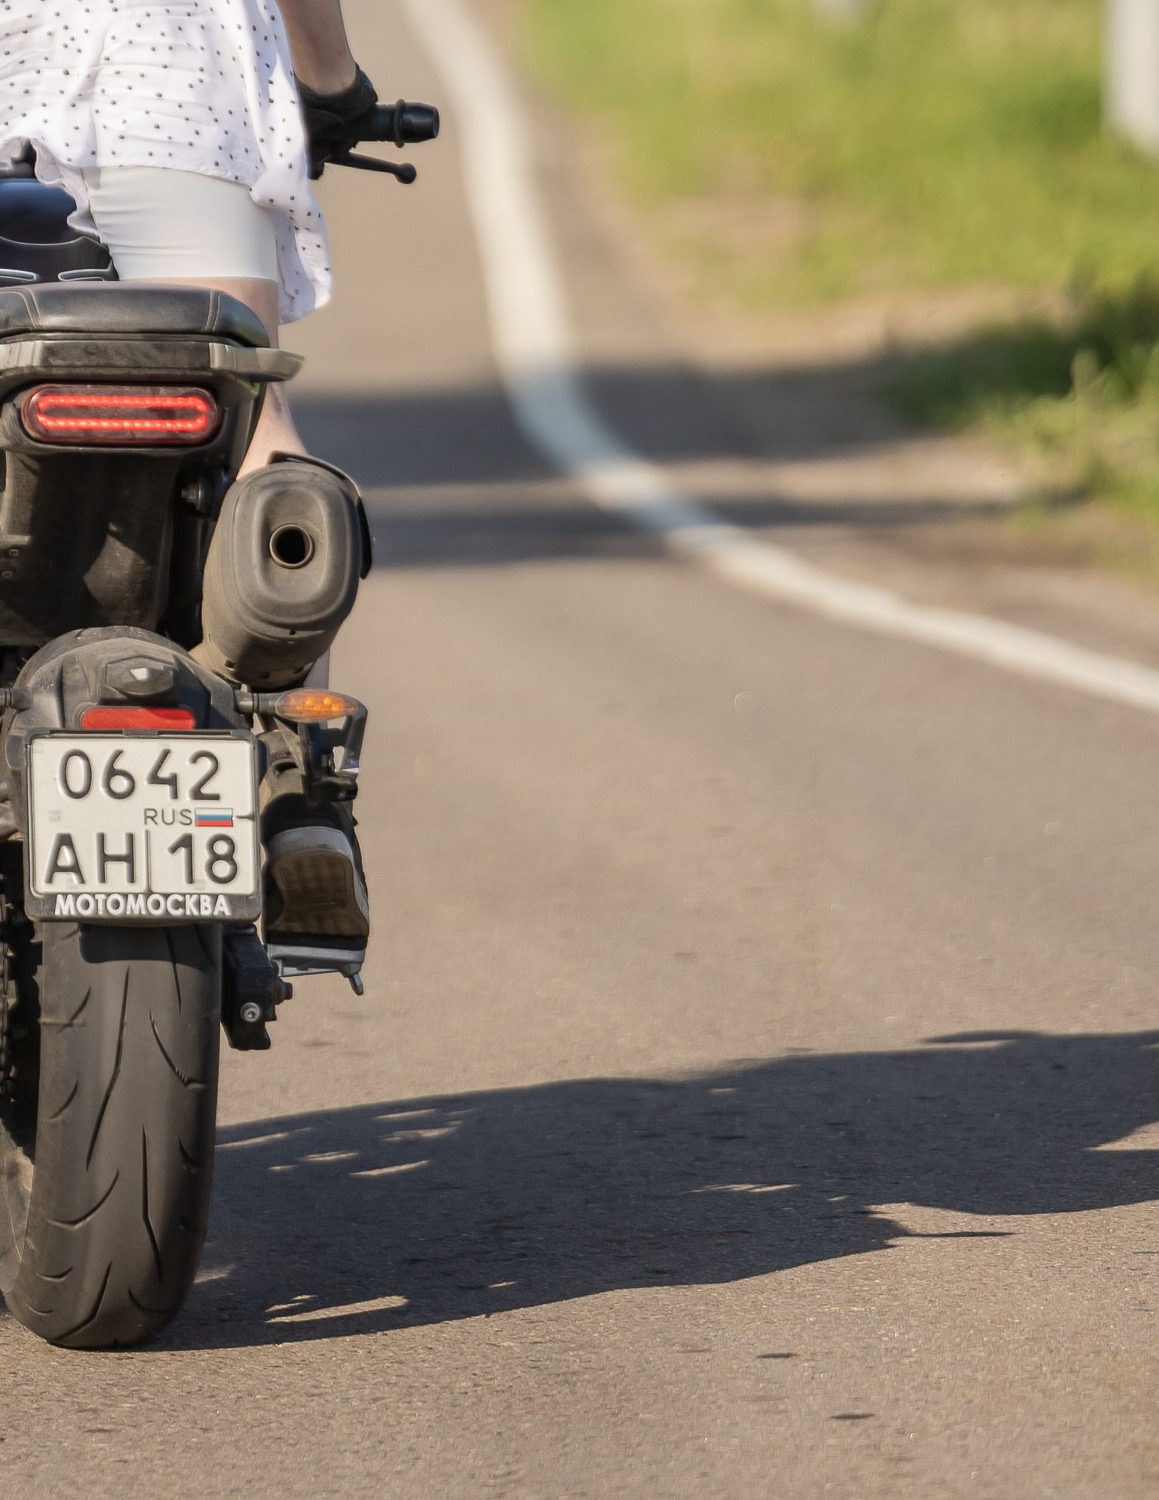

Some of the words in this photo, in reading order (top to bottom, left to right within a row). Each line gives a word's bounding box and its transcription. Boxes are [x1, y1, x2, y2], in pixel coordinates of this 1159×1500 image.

[58, 749, 221, 801] 0642
[144, 808, 193, 826] RUS
[167, 832, 238, 885] 18
[54, 893, 232, 917] МОТОМОСКВА
